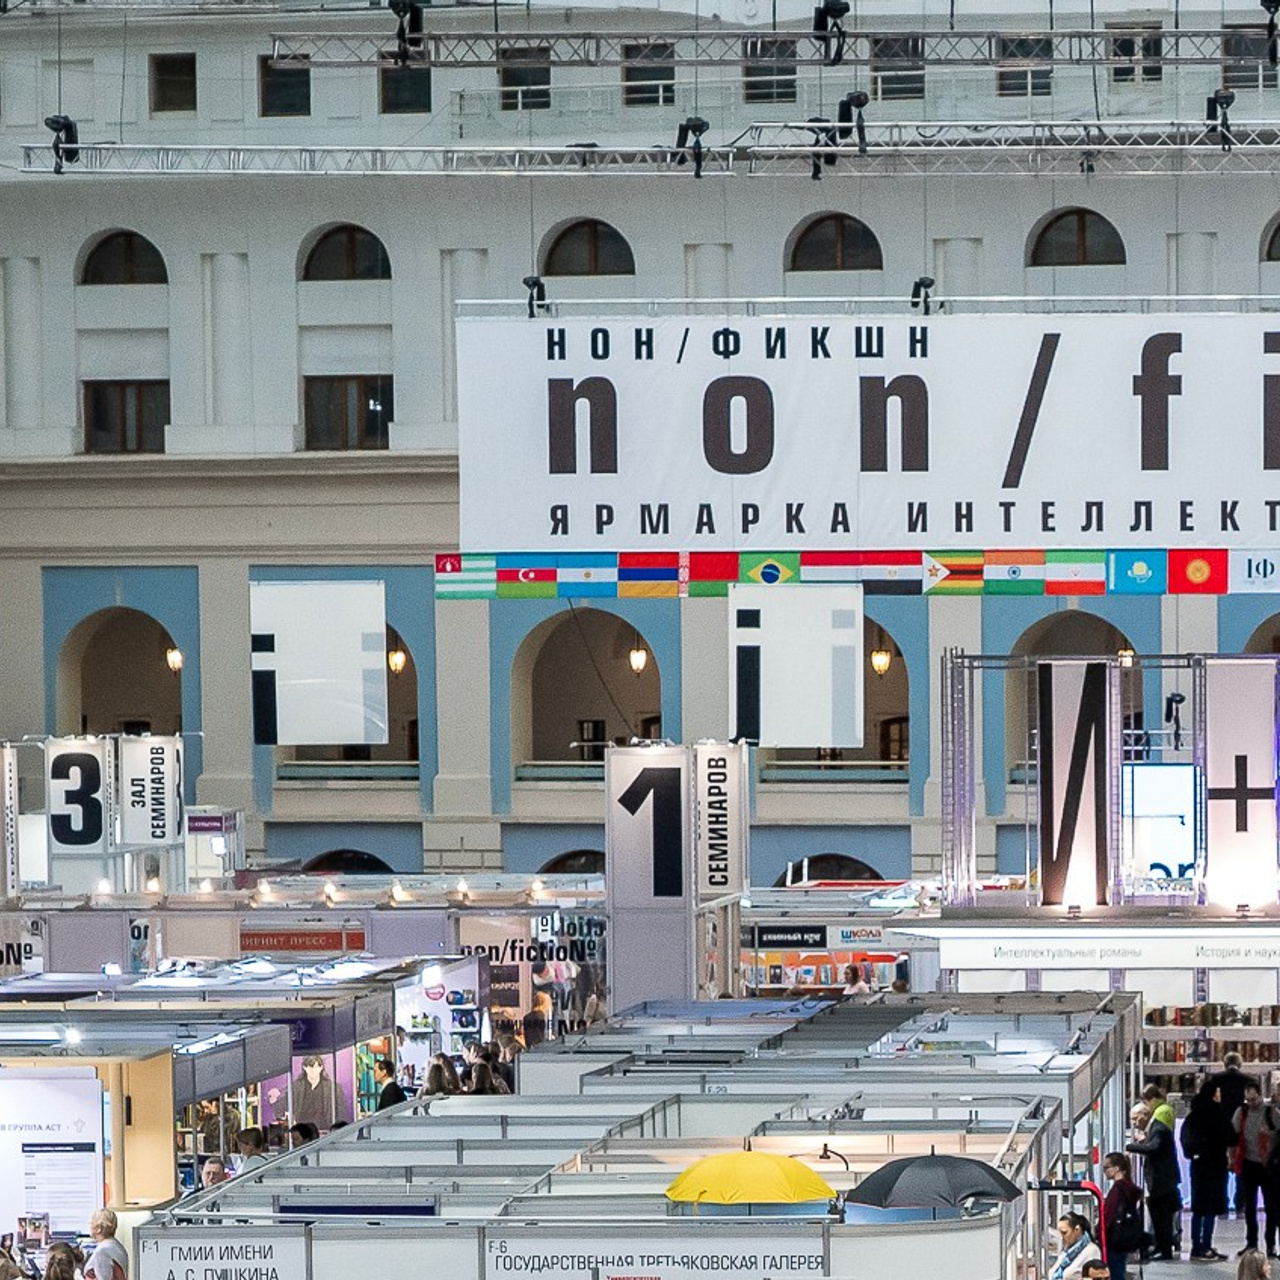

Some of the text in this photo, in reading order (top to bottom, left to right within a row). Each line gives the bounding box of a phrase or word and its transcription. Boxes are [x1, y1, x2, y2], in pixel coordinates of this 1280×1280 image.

[546, 327, 930, 361] НОН/ФИКШН
[550, 501, 851, 535] ЯРМАРКА
[51, 753, 103, 845] 3
[131, 777, 146, 808] ЗАЛ
[151, 746, 166, 839] СЕМИНАРОВ
[617, 767, 682, 896] 1
[708, 756, 728, 886] СЕМИНАРОВ
[994, 946, 1142, 960] Интеллектуальные романы
[1196, 946, 1241, 959] История
[142, 1241, 159, 1252] F-1
[170, 1244, 274, 1261] ГМИИ ИМЕНИ
[488, 1241, 508, 1253] F-6
[495, 1255, 824, 1273] ГОСУДАРСТВЕННАЯ ТРЕТЬЯКОВСКАЯ ГАЛЕРЕЯ
